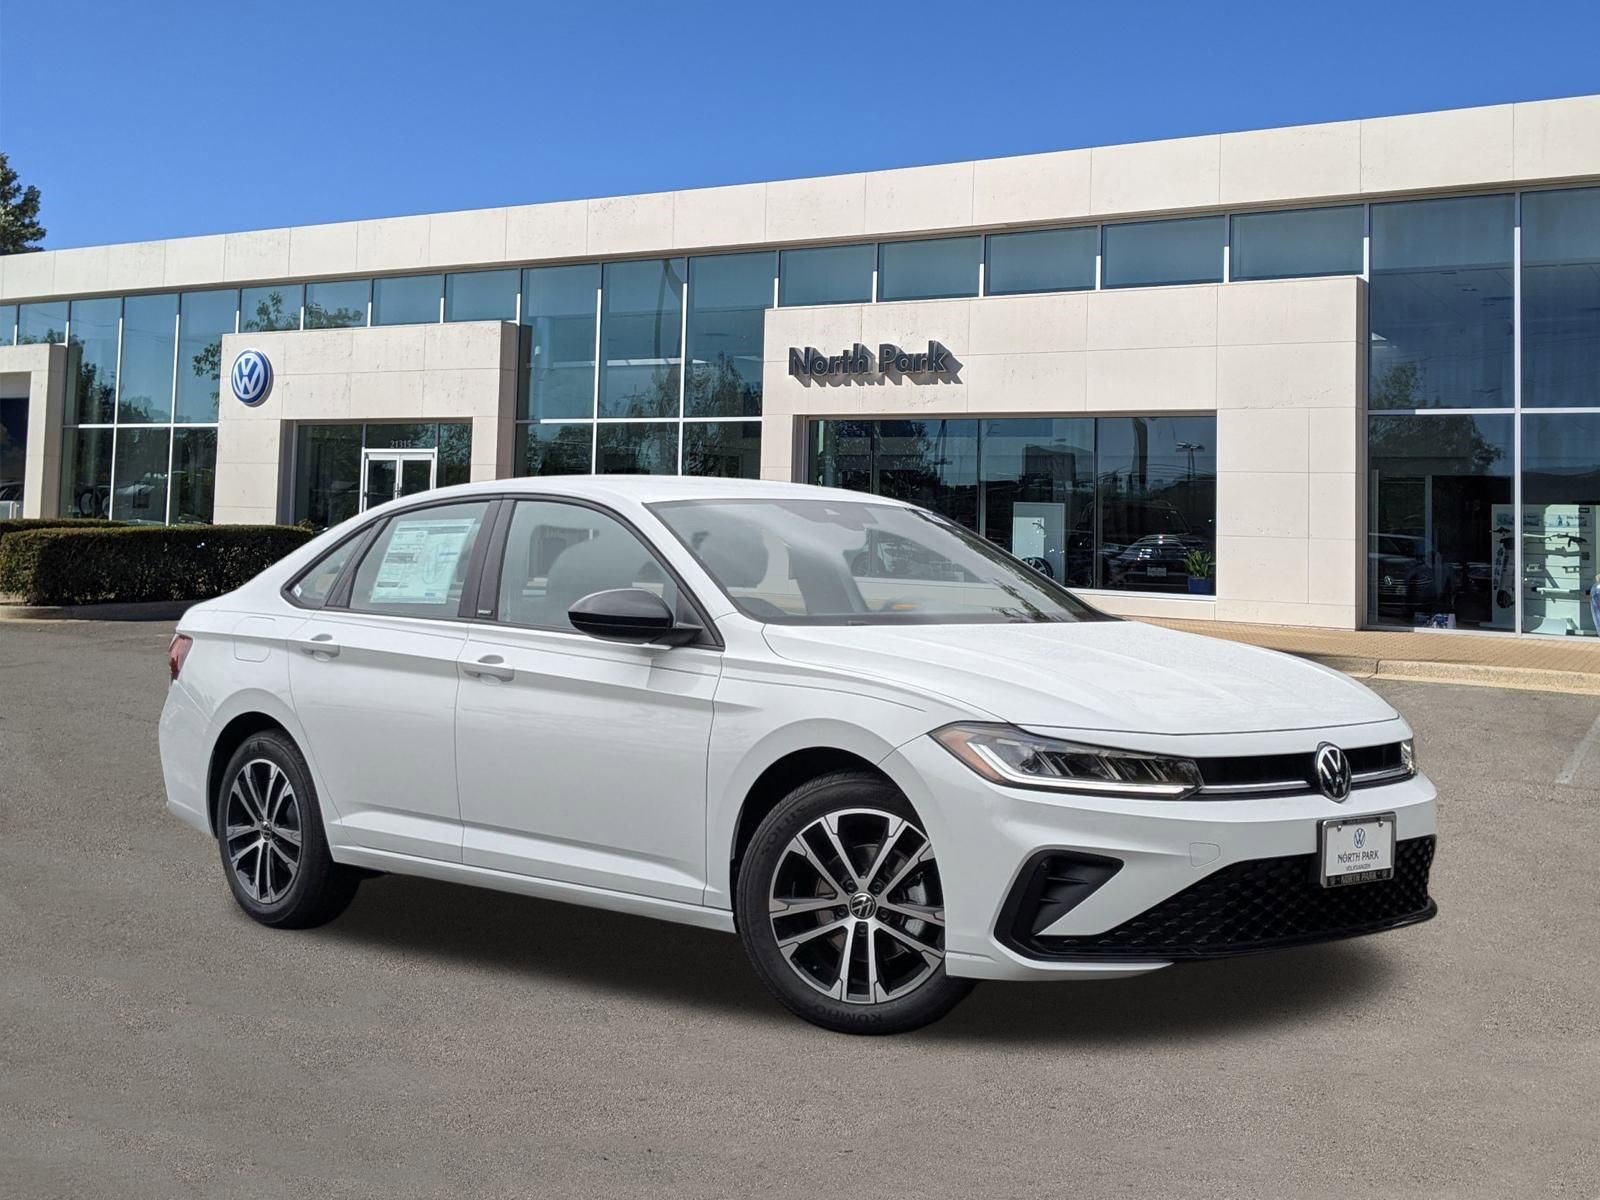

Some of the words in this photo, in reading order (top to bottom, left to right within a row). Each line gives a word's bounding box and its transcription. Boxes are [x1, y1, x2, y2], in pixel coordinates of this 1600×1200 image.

[789, 343, 872, 375] North
[879, 340, 947, 373] Park
[231, 350, 269, 403] VW
[1337, 851, 1360, 864] NORTH
[1362, 850, 1380, 861] PARK
